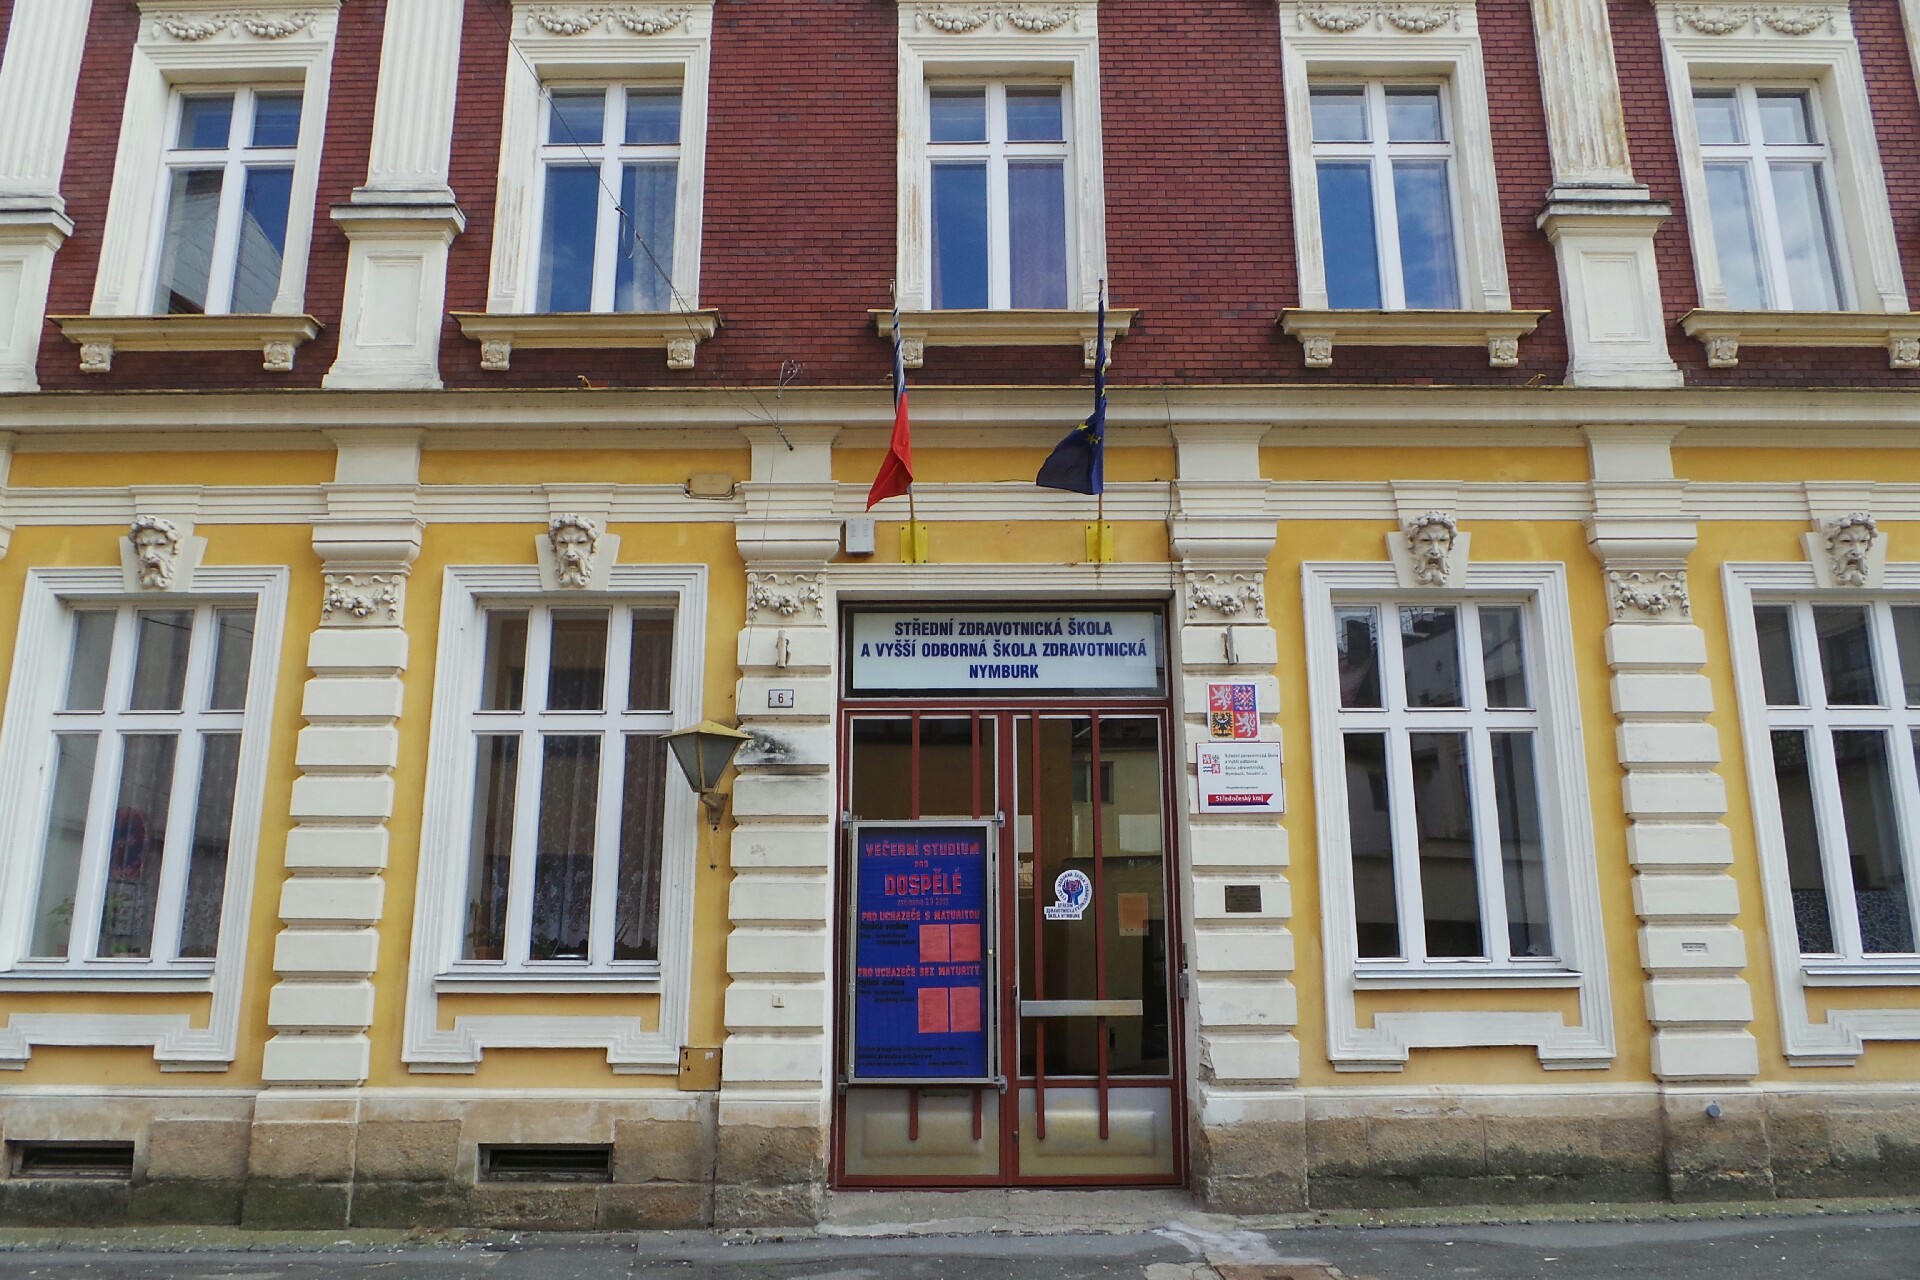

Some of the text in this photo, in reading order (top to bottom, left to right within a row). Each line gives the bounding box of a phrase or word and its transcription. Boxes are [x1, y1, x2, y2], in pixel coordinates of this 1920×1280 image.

[894, 617, 1113, 635] STŘEDNÍ ZDRAVOTNICKÁ ŠKOLA
[861, 638, 1147, 657] A VYŠŠÍ ODBORNÁ ŠKOLA ZDRAVOTNICKÁ
[969, 664, 1039, 679] NYMBURK
[778, 692, 784, 704] 6
[865, 840, 980, 857] VEČERNÍ STUDIUM
[914, 860, 929, 868] PRO
[884, 867, 962, 896] DOSPĚLÉ
[861, 908, 980, 921] PRO UCHAZEČE S MATURITOU
[857, 964, 980, 977] PRO UCHAZEČE BEZ MATURITY
